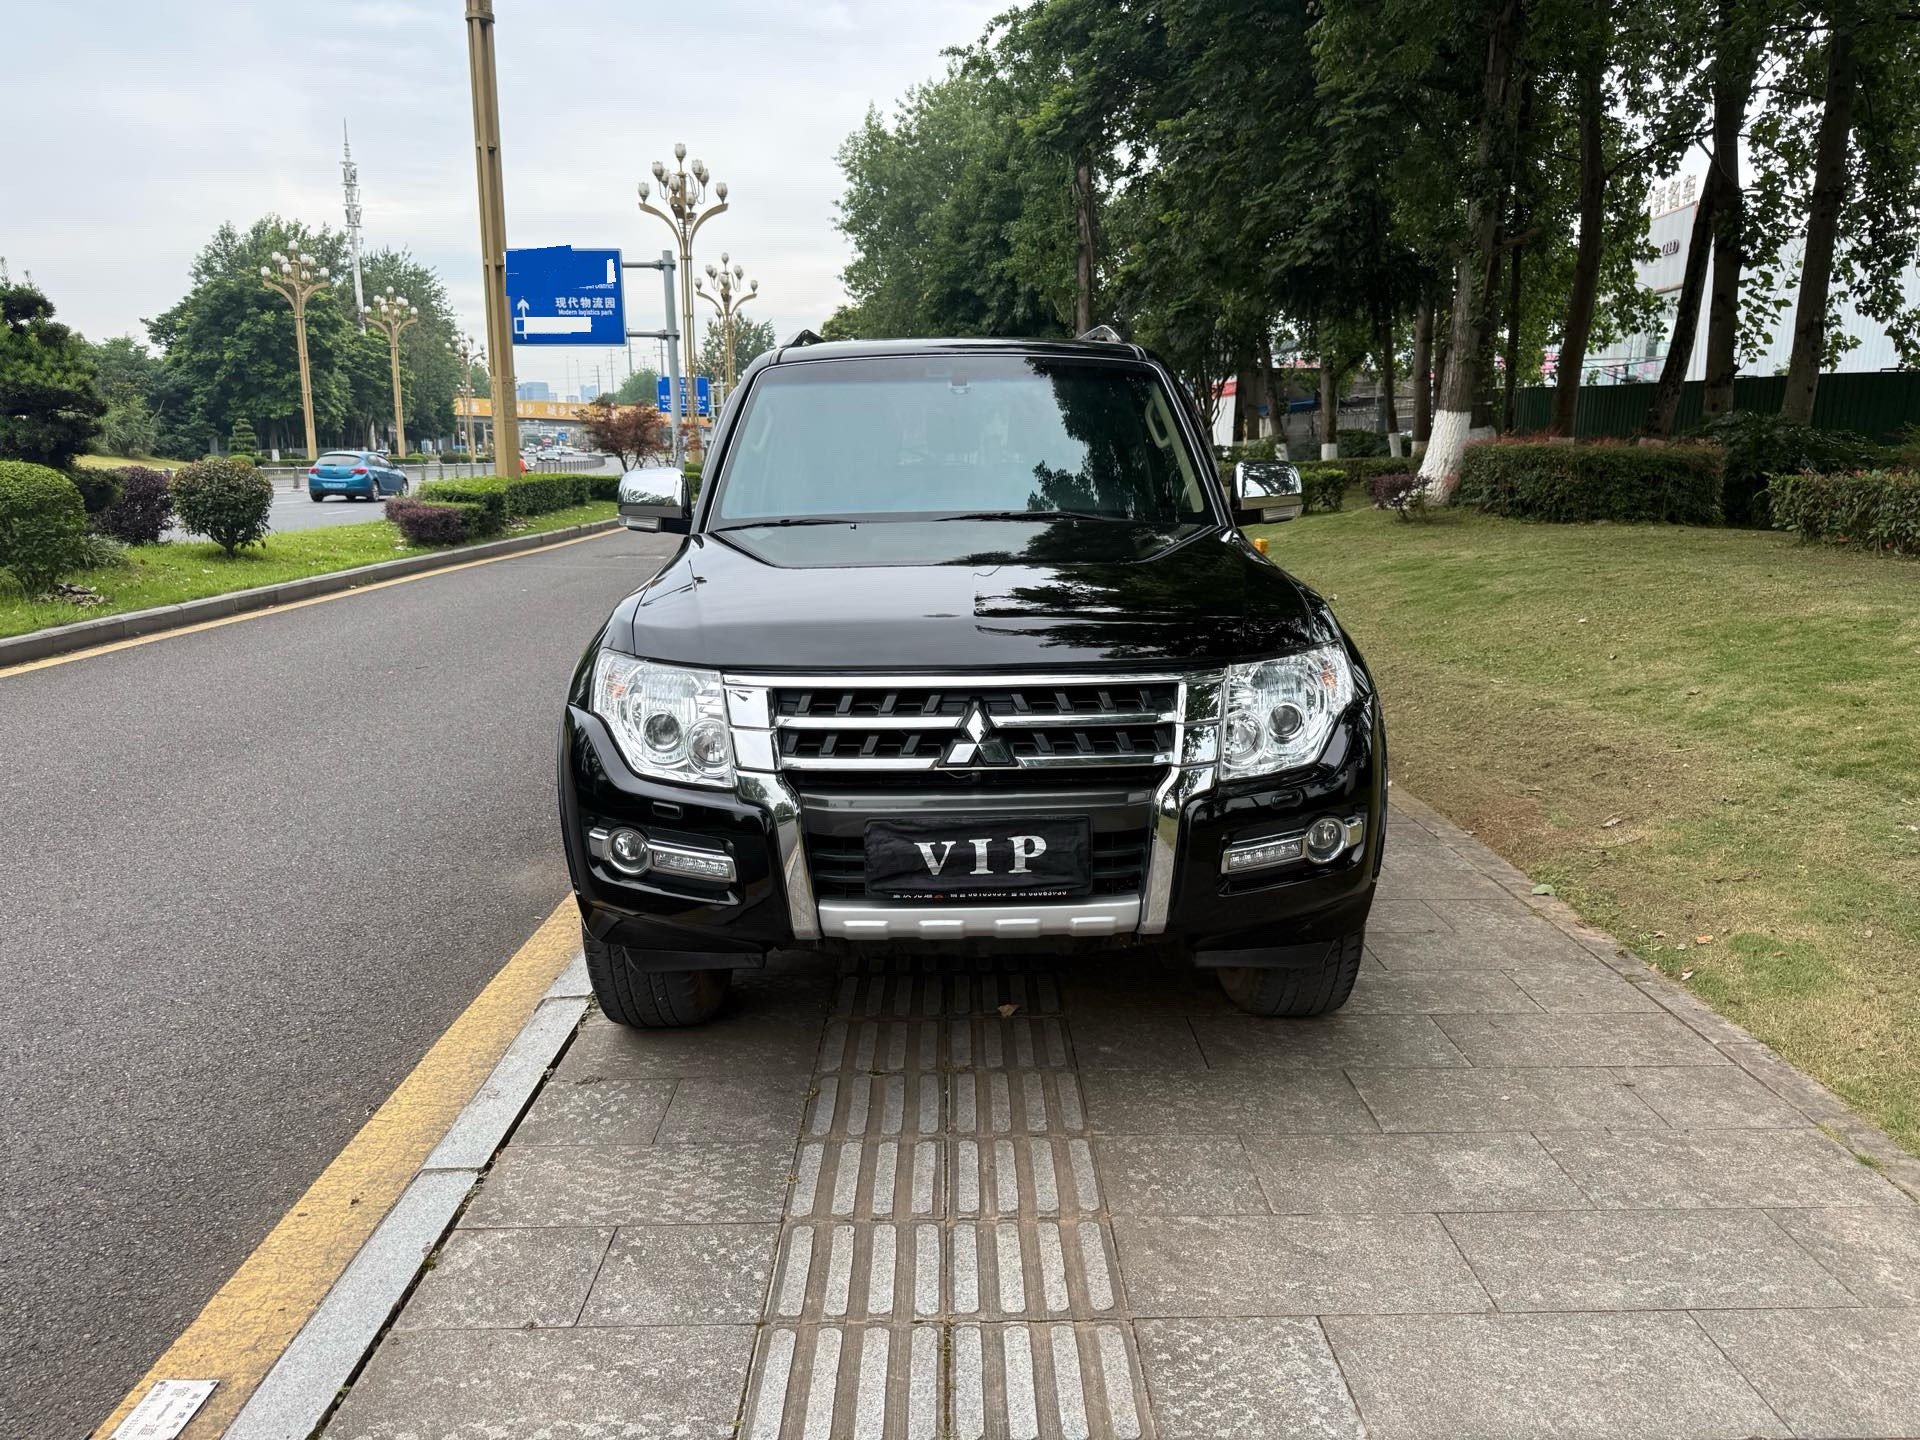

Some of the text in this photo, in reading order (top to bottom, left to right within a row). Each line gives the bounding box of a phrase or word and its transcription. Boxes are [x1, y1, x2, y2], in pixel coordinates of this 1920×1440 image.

[555, 297, 616, 309] 现代物流园
[914, 835, 1047, 876] VIP
